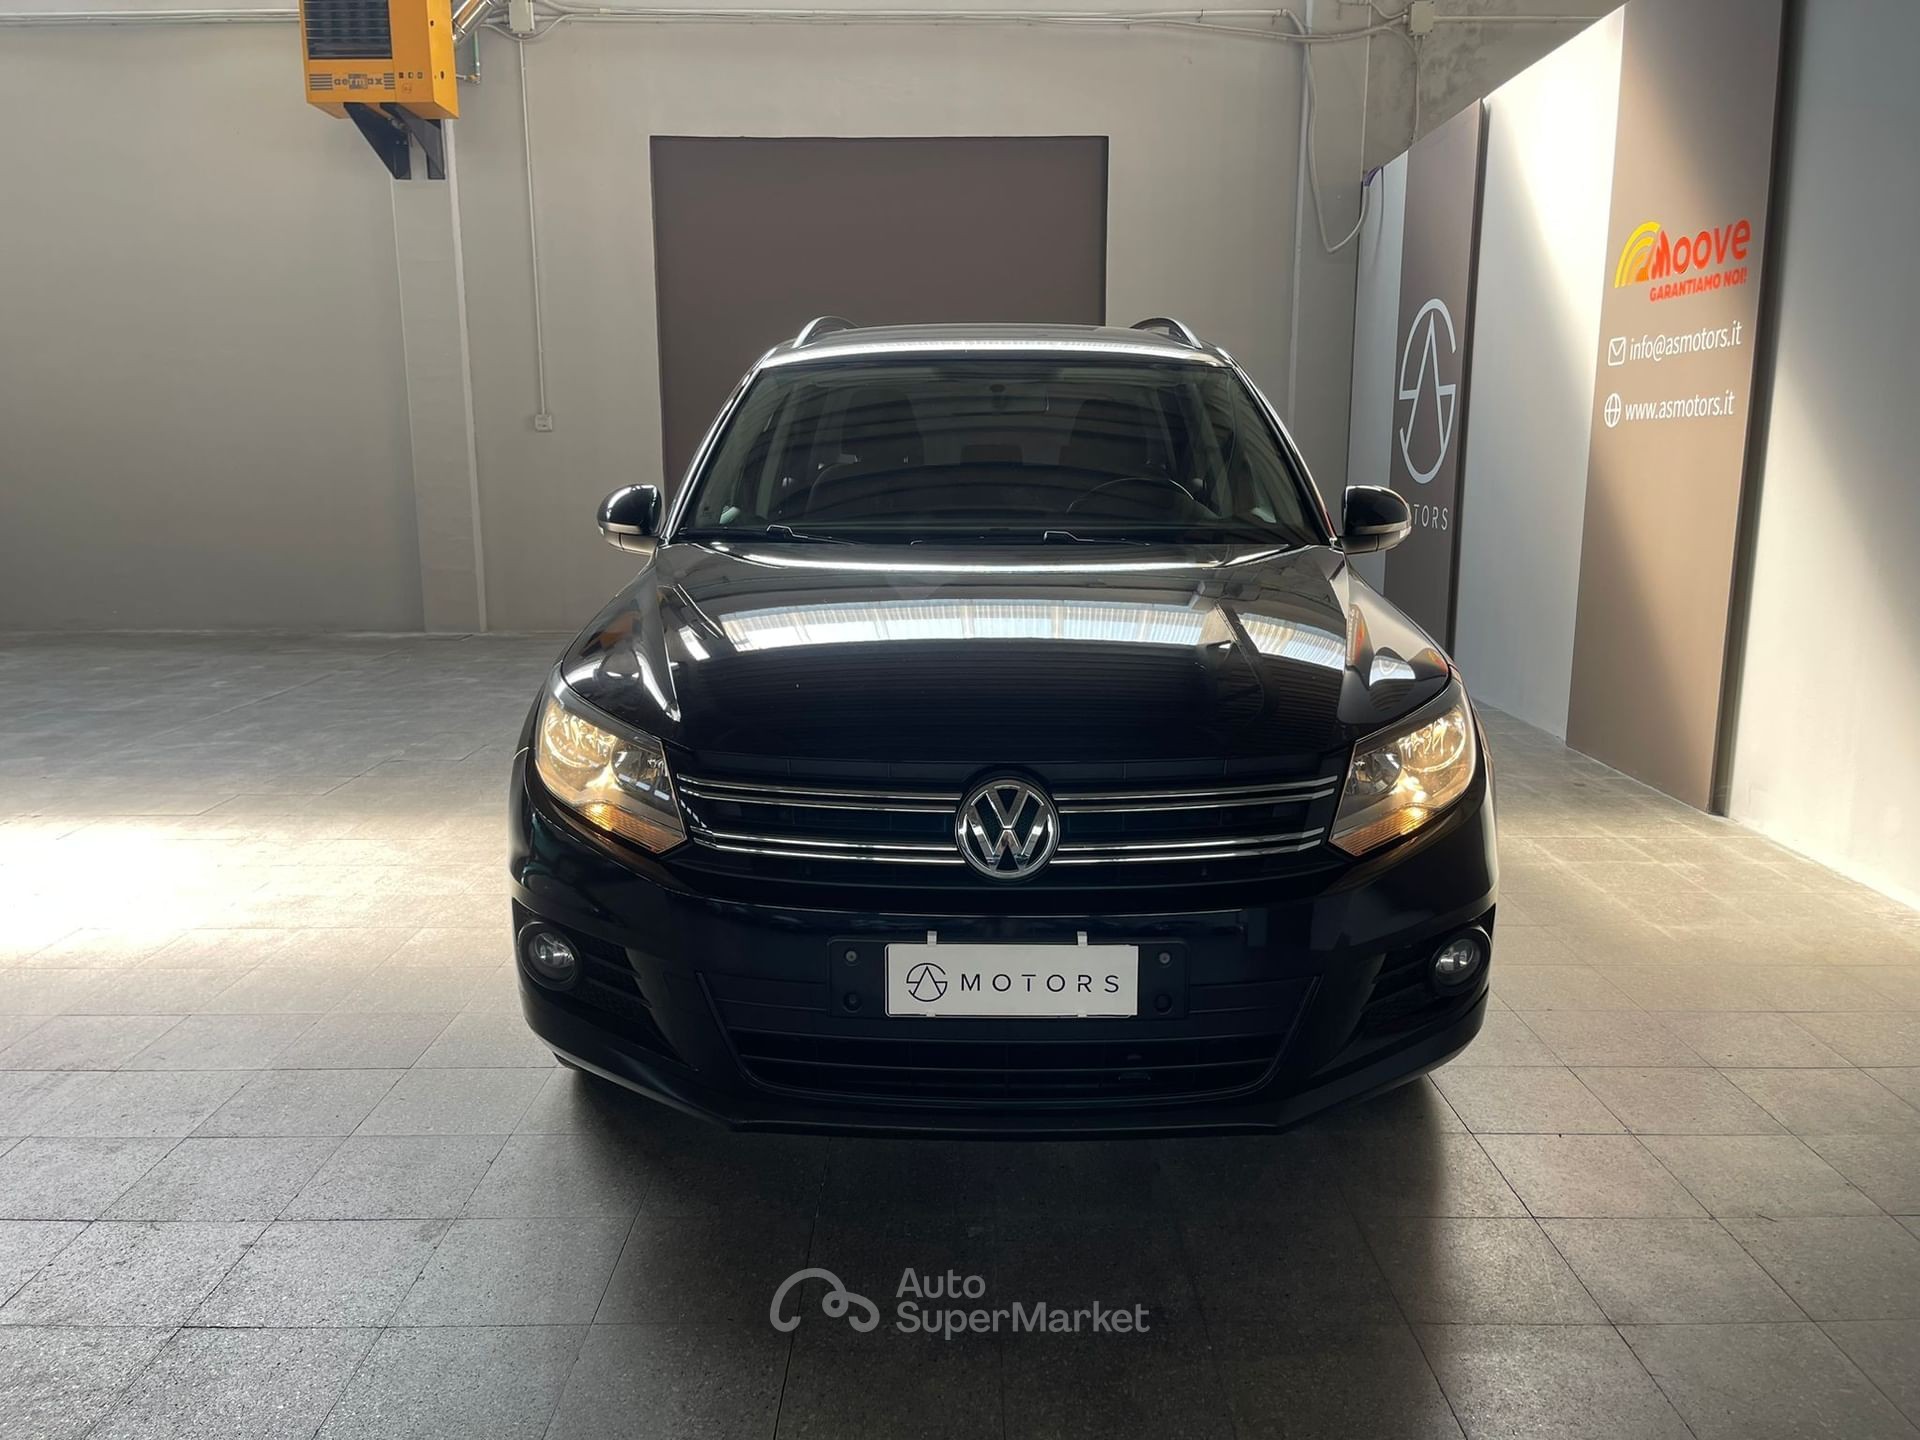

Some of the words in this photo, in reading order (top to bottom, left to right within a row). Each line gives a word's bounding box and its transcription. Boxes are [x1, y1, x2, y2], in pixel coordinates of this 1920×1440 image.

[1649, 273, 1721, 303] GARANTIAMO
[1629, 320, 1742, 362] info@asmotors.it
[1624, 390, 1735, 421] www.asmotors.it
[1413, 503, 1449, 531] TORS
[960, 973, 1119, 993] MOTORS
